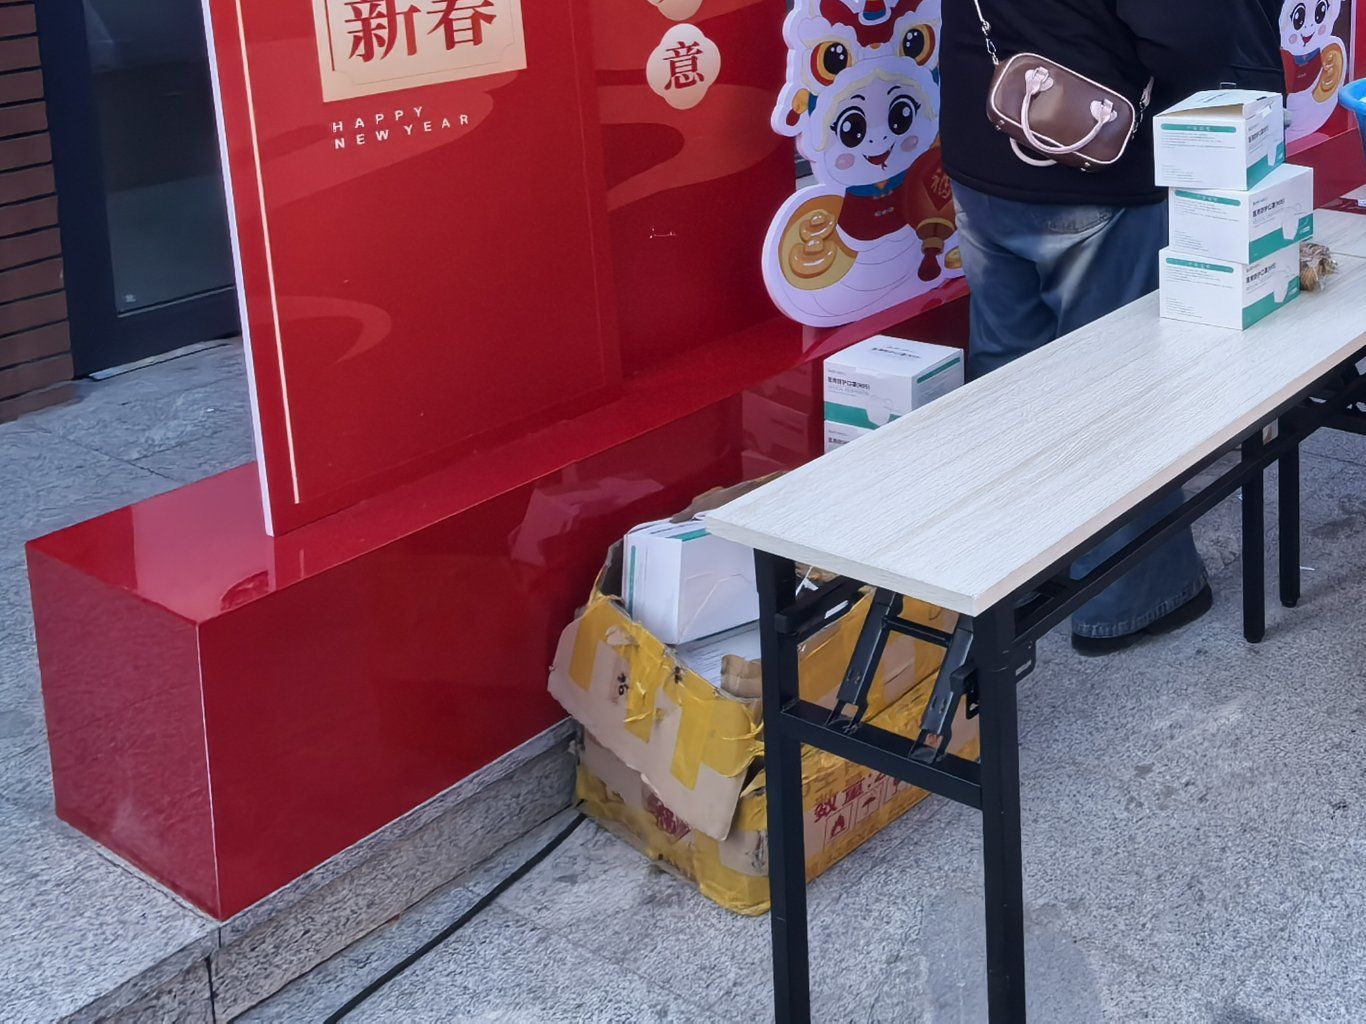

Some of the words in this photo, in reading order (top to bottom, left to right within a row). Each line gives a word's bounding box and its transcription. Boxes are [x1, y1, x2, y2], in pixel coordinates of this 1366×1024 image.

[332, 106, 423, 133] HAPPY
[334, 129, 390, 150] NEW
[403, 114, 469, 136] YEAR
